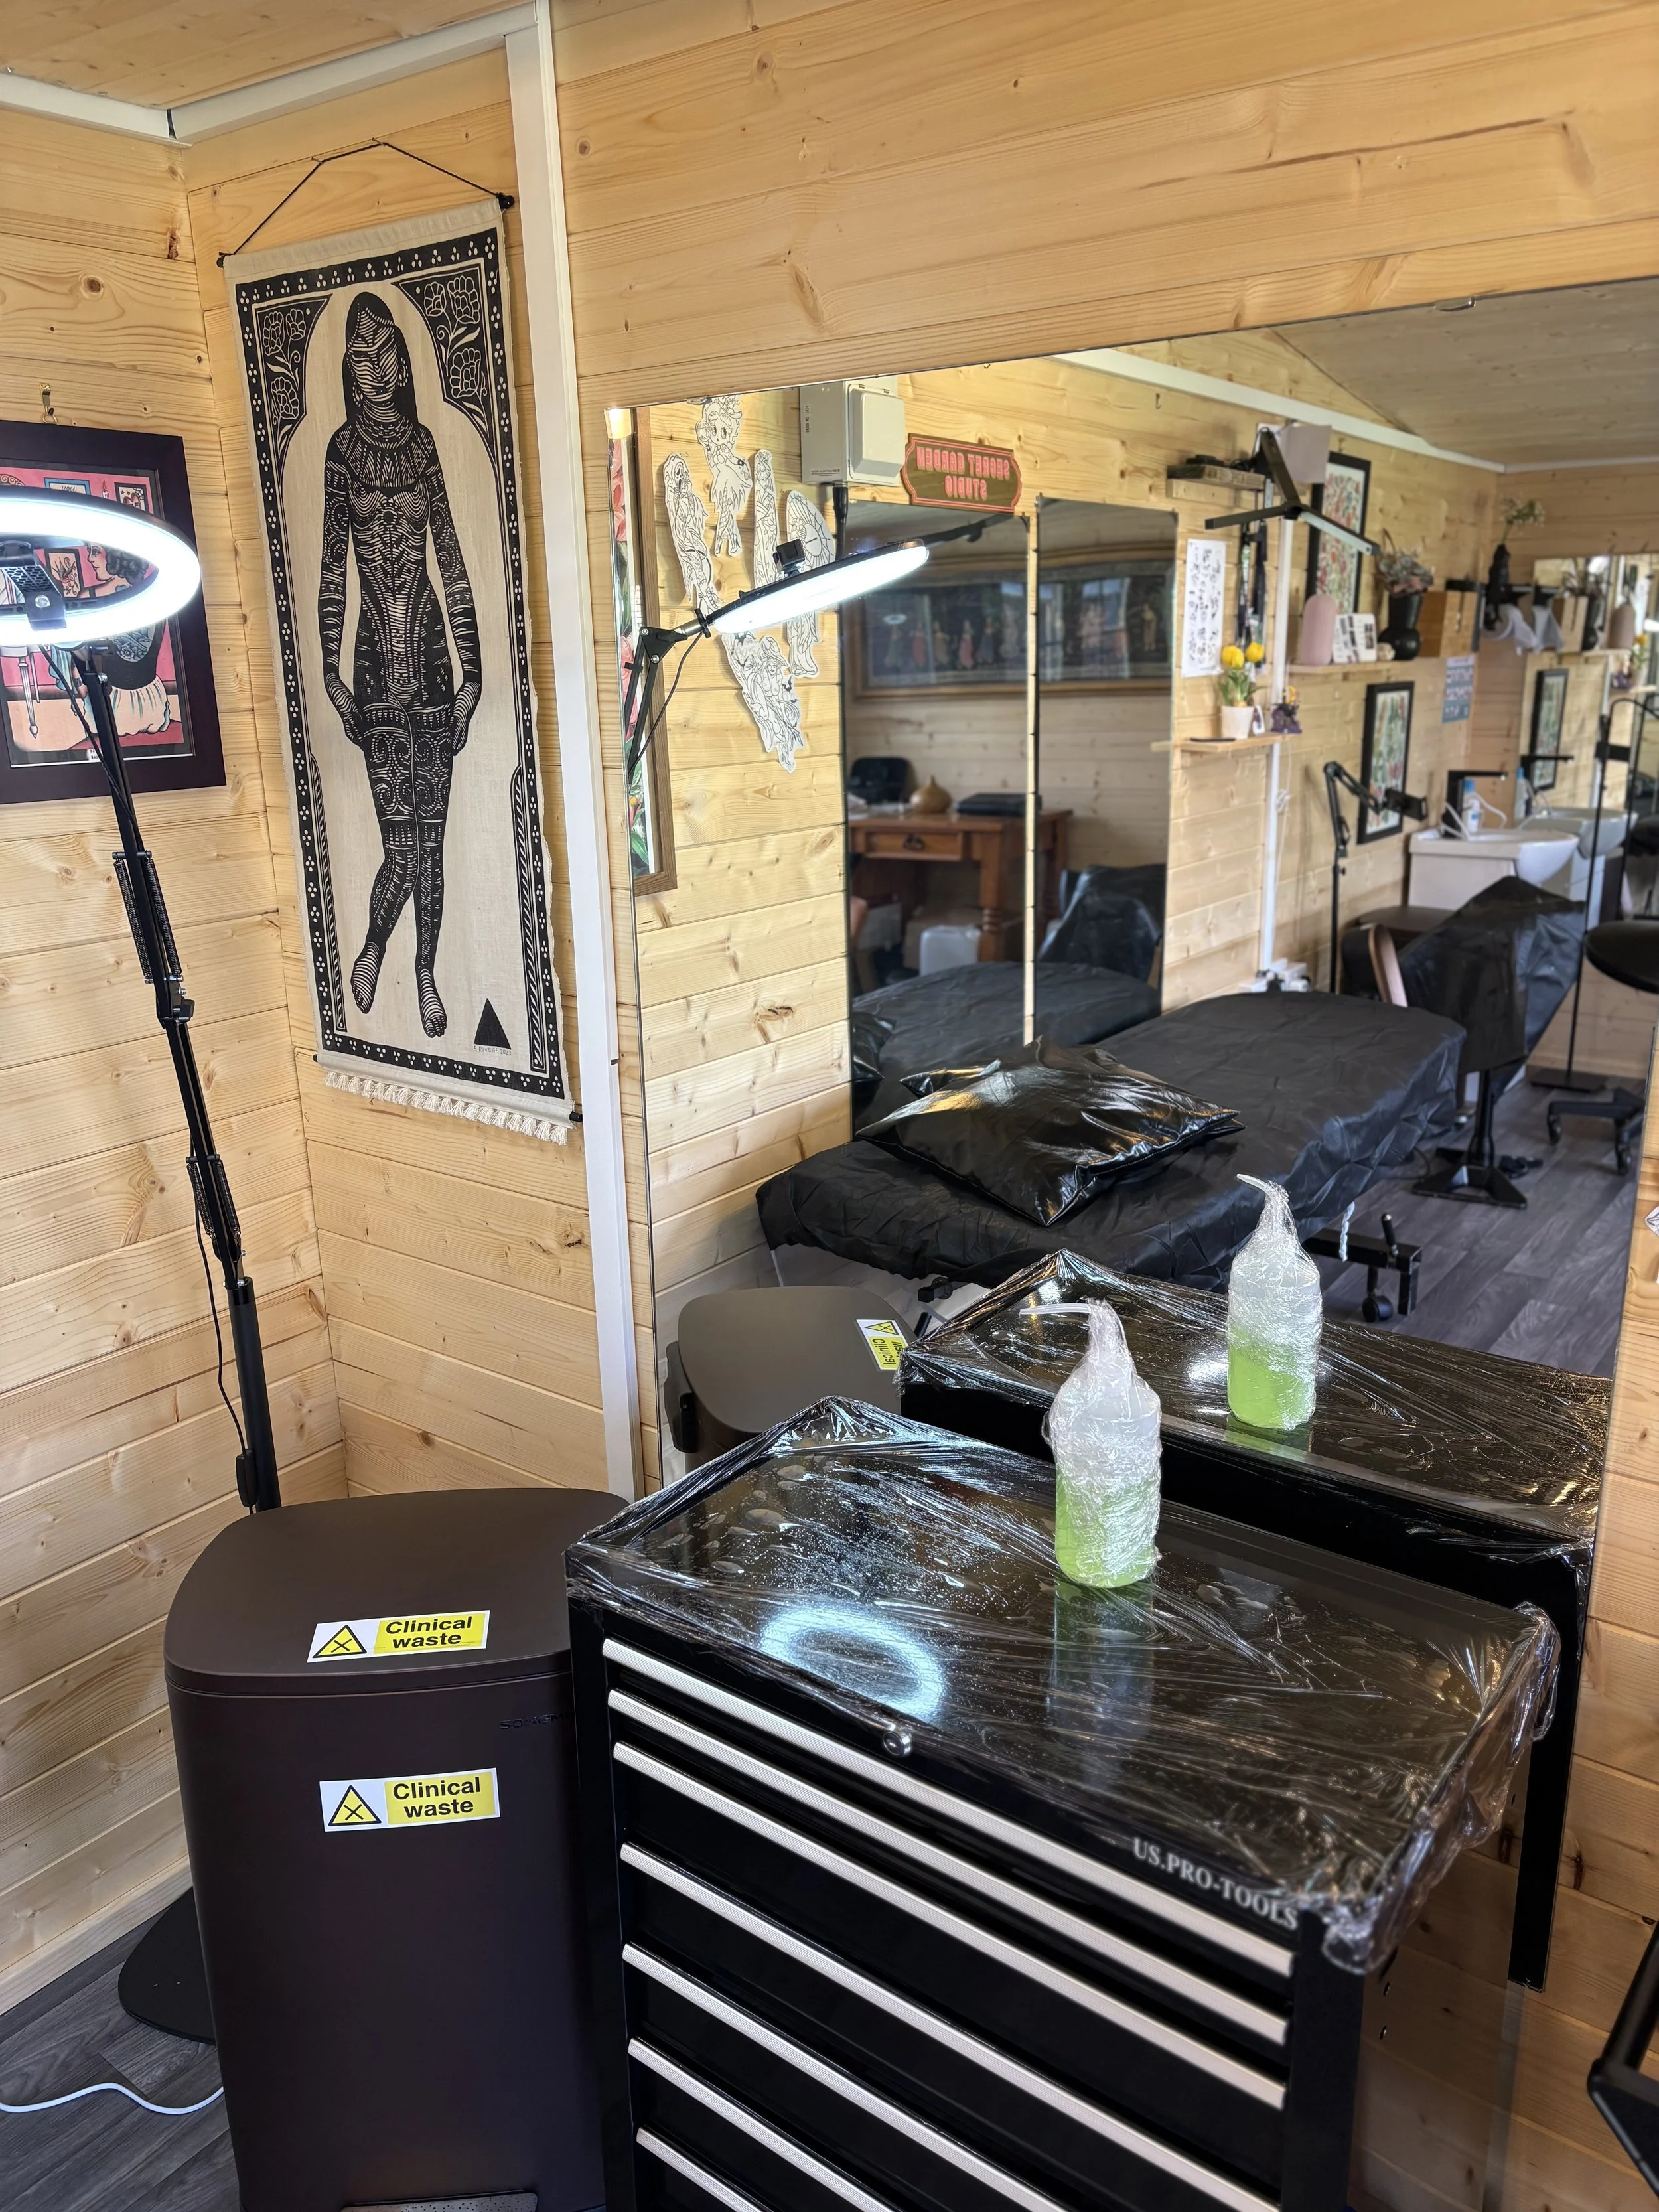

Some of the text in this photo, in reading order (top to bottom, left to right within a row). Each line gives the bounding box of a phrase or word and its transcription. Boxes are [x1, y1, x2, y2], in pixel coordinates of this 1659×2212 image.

[386, 1615, 472, 1635] Clinical
[392, 1633, 462, 1649] waste
[393, 1776, 481, 1800] Clinical
[403, 1798, 474, 1818] waste
[1133, 1836, 1299, 1931] US.PRO-TOOLS
